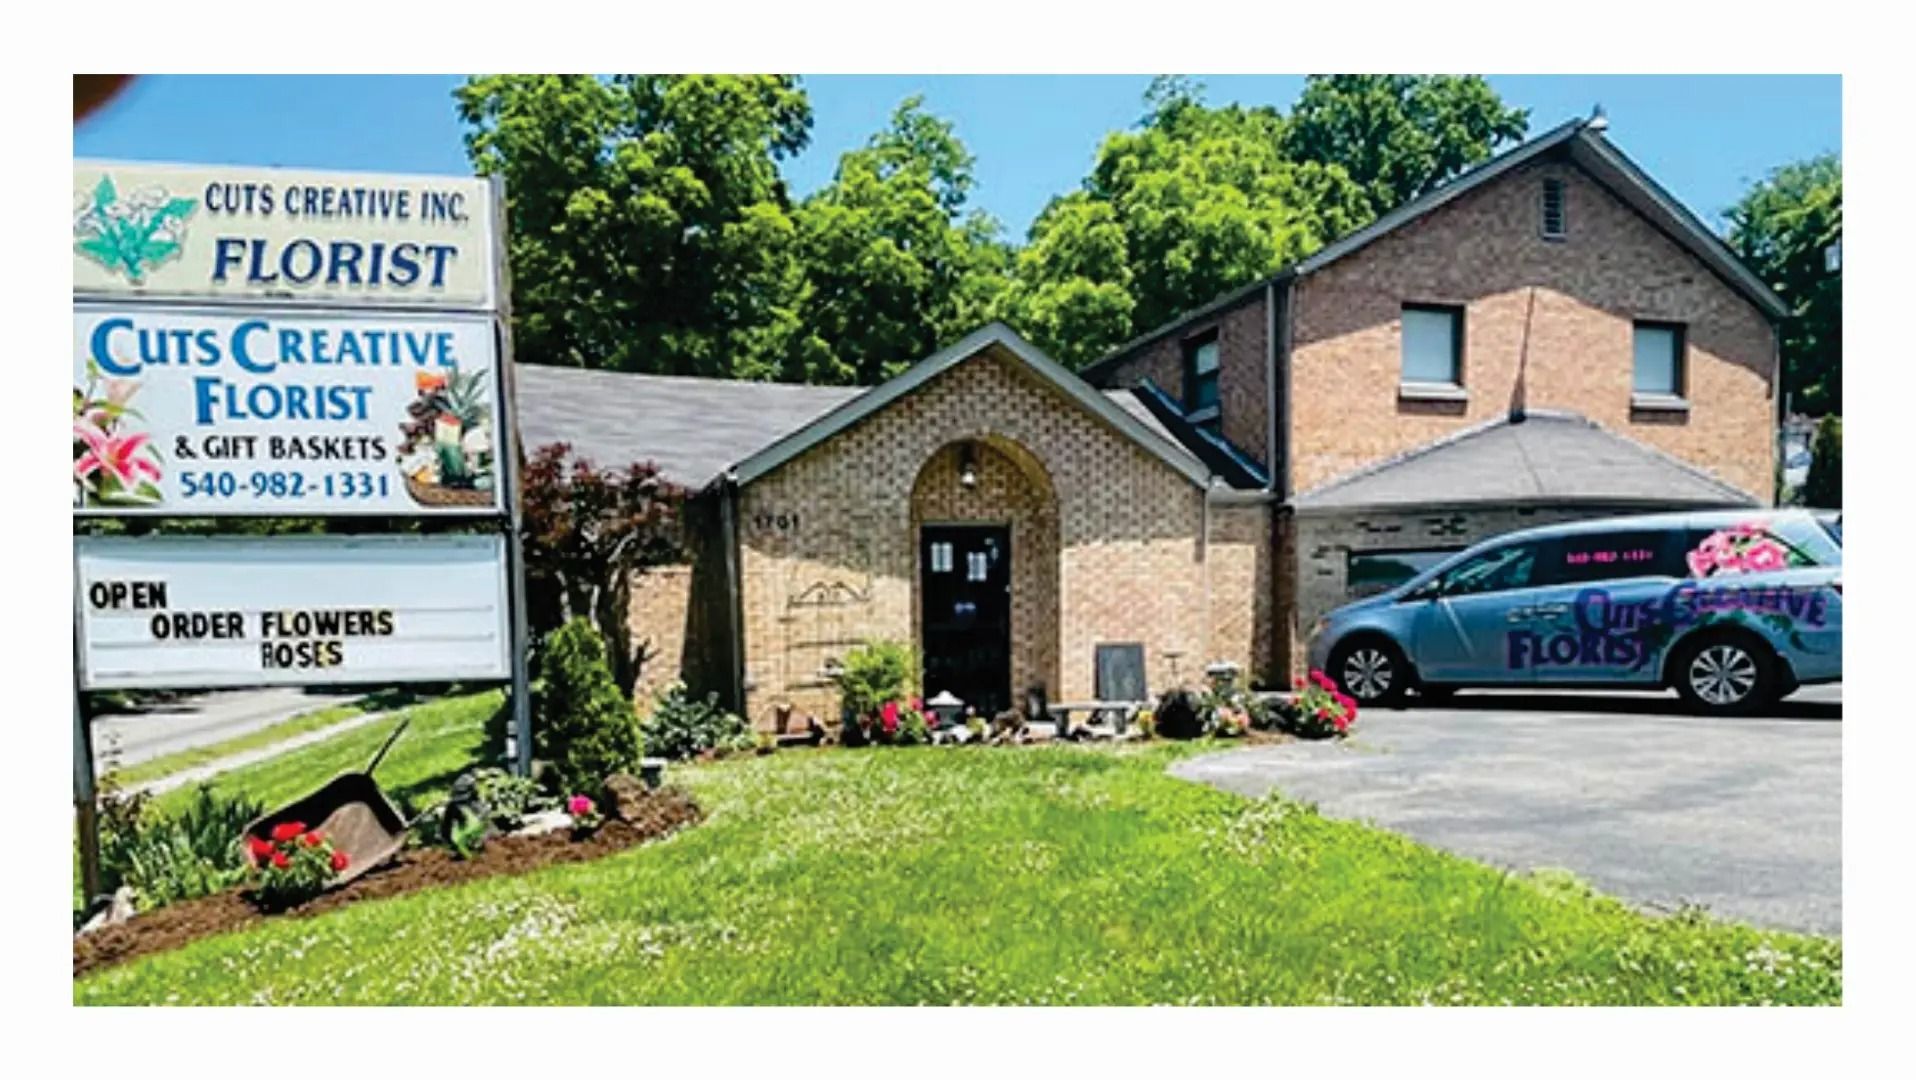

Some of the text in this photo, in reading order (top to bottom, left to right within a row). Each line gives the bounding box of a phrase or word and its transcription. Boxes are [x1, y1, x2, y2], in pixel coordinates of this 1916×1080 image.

[206, 182, 469, 223] CUTS CREATIVE INC.
[212, 237, 459, 287] FLORIST
[230, 319, 457, 374] CREATIVE
[193, 376, 373, 425] FLORIST
[174, 435, 387, 460] & GIFT BASKETS
[180, 471, 389, 498] 540-982-1331
[89, 581, 167, 609] OPEN
[151, 610, 394, 639] ORDER FLOWERS
[261, 640, 343, 668] ROSES
